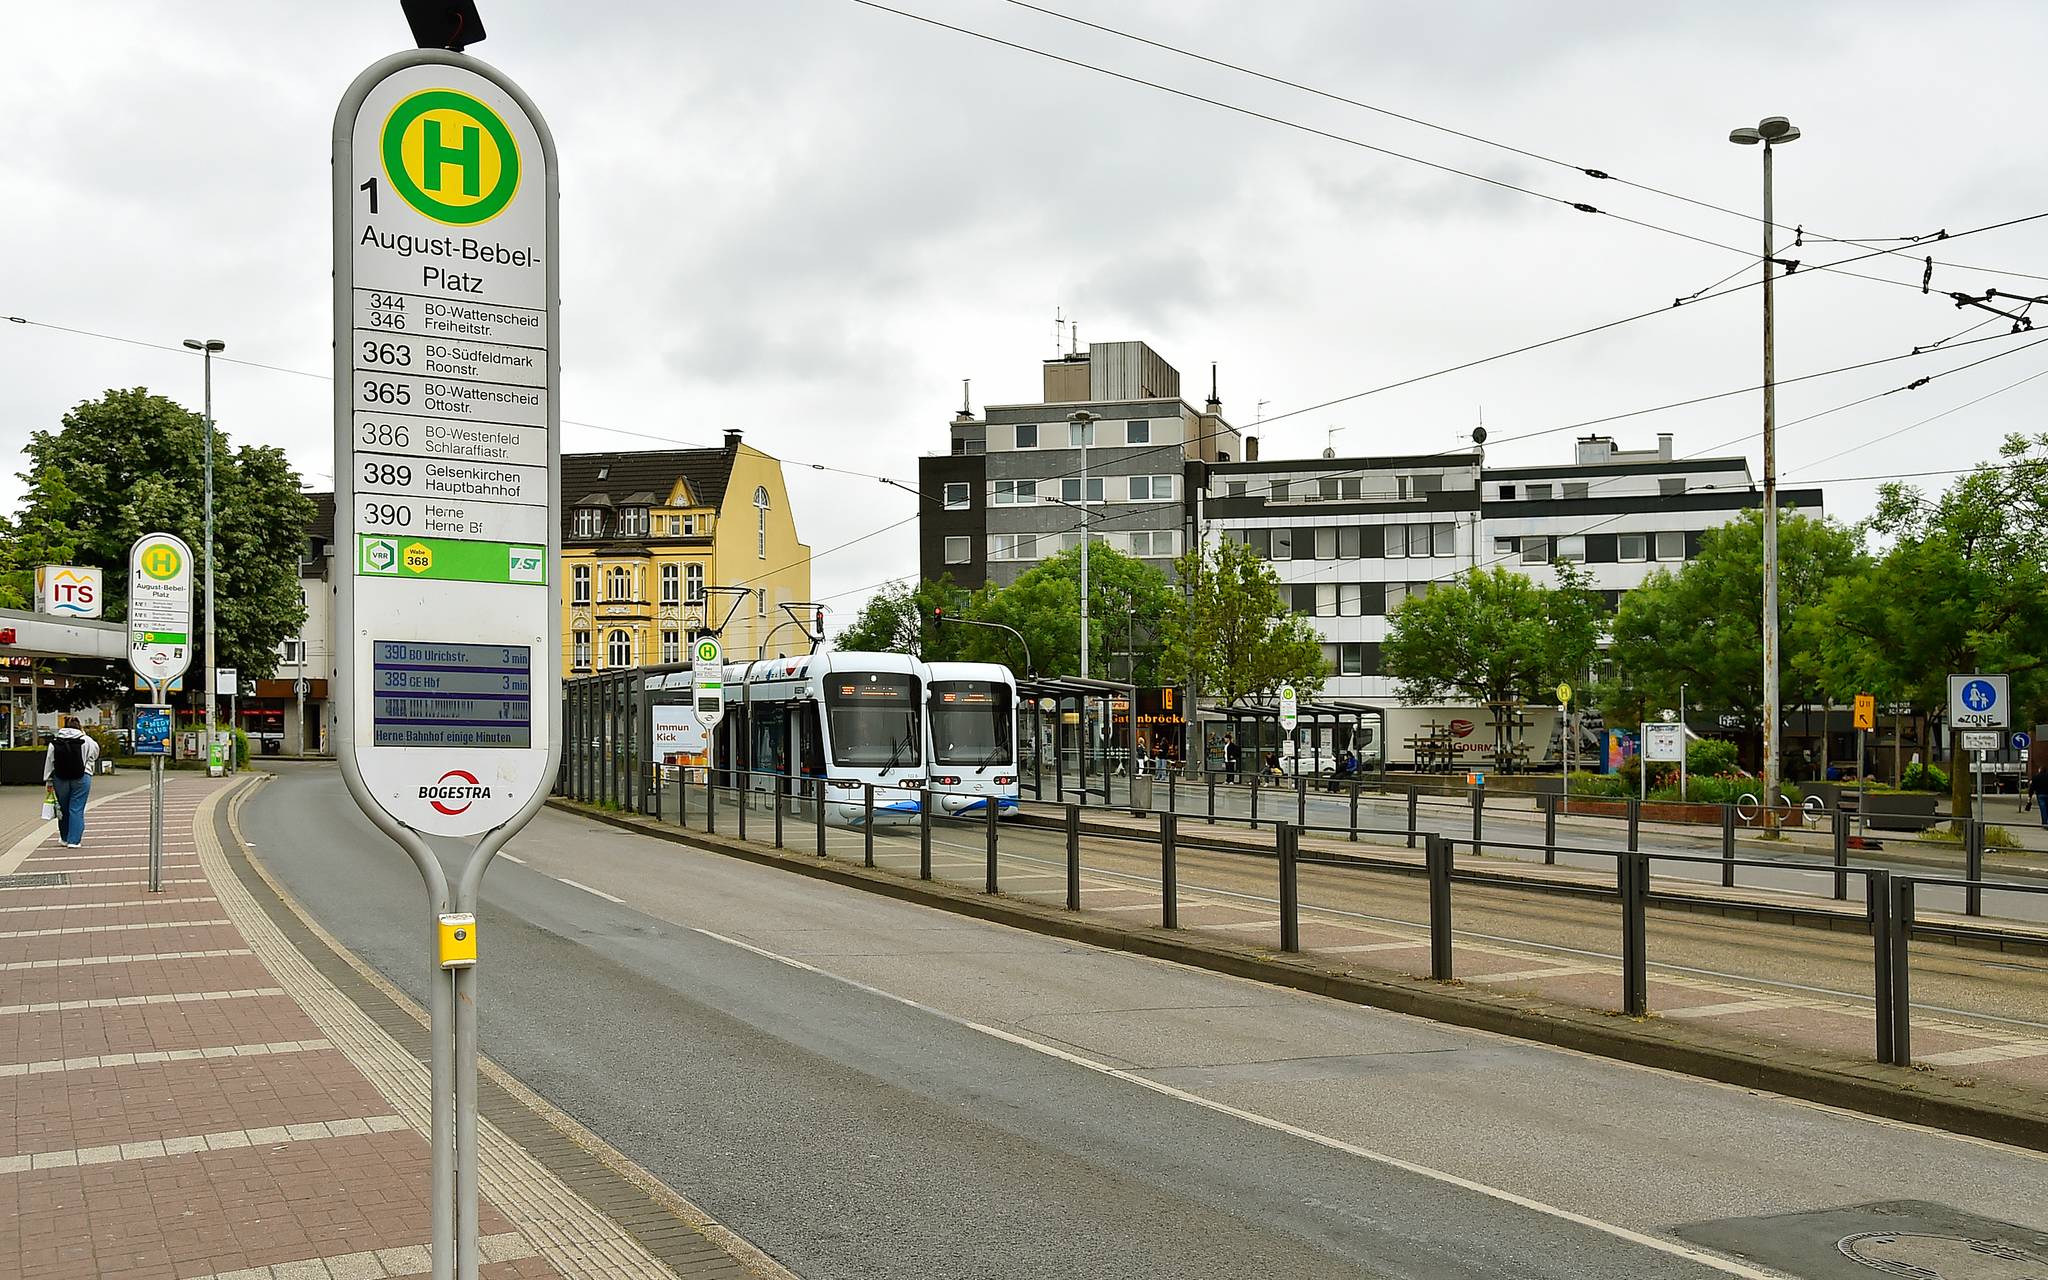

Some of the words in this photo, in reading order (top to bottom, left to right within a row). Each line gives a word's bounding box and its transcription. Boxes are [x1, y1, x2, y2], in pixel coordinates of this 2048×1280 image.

[424, 118, 480, 197] H
[360, 177, 378, 214] 1
[360, 225, 541, 267] August-Bebel-
[423, 266, 484, 294] Platz
[370, 294, 405, 311] 344
[370, 312, 406, 330] 346
[425, 303, 539, 327] BO-Wattenscheid
[425, 318, 492, 336] Freiheitstr.
[362, 341, 411, 366] 363
[426, 345, 534, 367] BO-Südfeldmark
[426, 360, 479, 376] Roonstr.
[363, 381, 411, 405] 365
[425, 383, 539, 405] BO-Wattenscheid
[425, 398, 472, 413] Ottostr.
[362, 423, 410, 447] 386
[425, 425, 520, 445] BO-Westenfeld
[425, 440, 509, 459] Schlaraffiastr.
[364, 463, 412, 486] 389
[425, 464, 521, 483] Gelsenkirchen
[425, 479, 521, 497] Hauptbahnhof
[364, 503, 412, 526] 390
[425, 504, 464, 518] Herne
[425, 520, 464, 533] Herne
[469, 521, 483, 534] Bf
[373, 551, 388, 560] VRR
[407, 555, 429, 567] 368
[409, 548, 426, 556] Wabe
[153, 553, 170, 572] H
[136, 569, 141, 580] 1
[54, 583, 94, 603] ITS
[136, 583, 187, 592] August-Bebel-
[384, 645, 407, 660] 390
[424, 650, 469, 663] Ulrichstr.
[502, 649, 510, 663] 3
[512, 654, 528, 665] min
[704, 647, 711, 656] H
[384, 672, 407, 687] 389
[409, 676, 422, 688] GE
[424, 676, 441, 688] Hbf
[502, 676, 510, 690] 3
[512, 680, 528, 691] min
[1561, 687, 1568, 698] H
[656, 723, 689, 731] Immun
[1964, 714, 1994, 724] ZONE
[376, 730, 404, 742] Herne
[406, 730, 444, 743] Bahnhof
[446, 731, 474, 745] einige
[475, 731, 512, 743] Minuten
[656, 733, 676, 741] Kick
[418, 786, 491, 799] BOGESTRA
